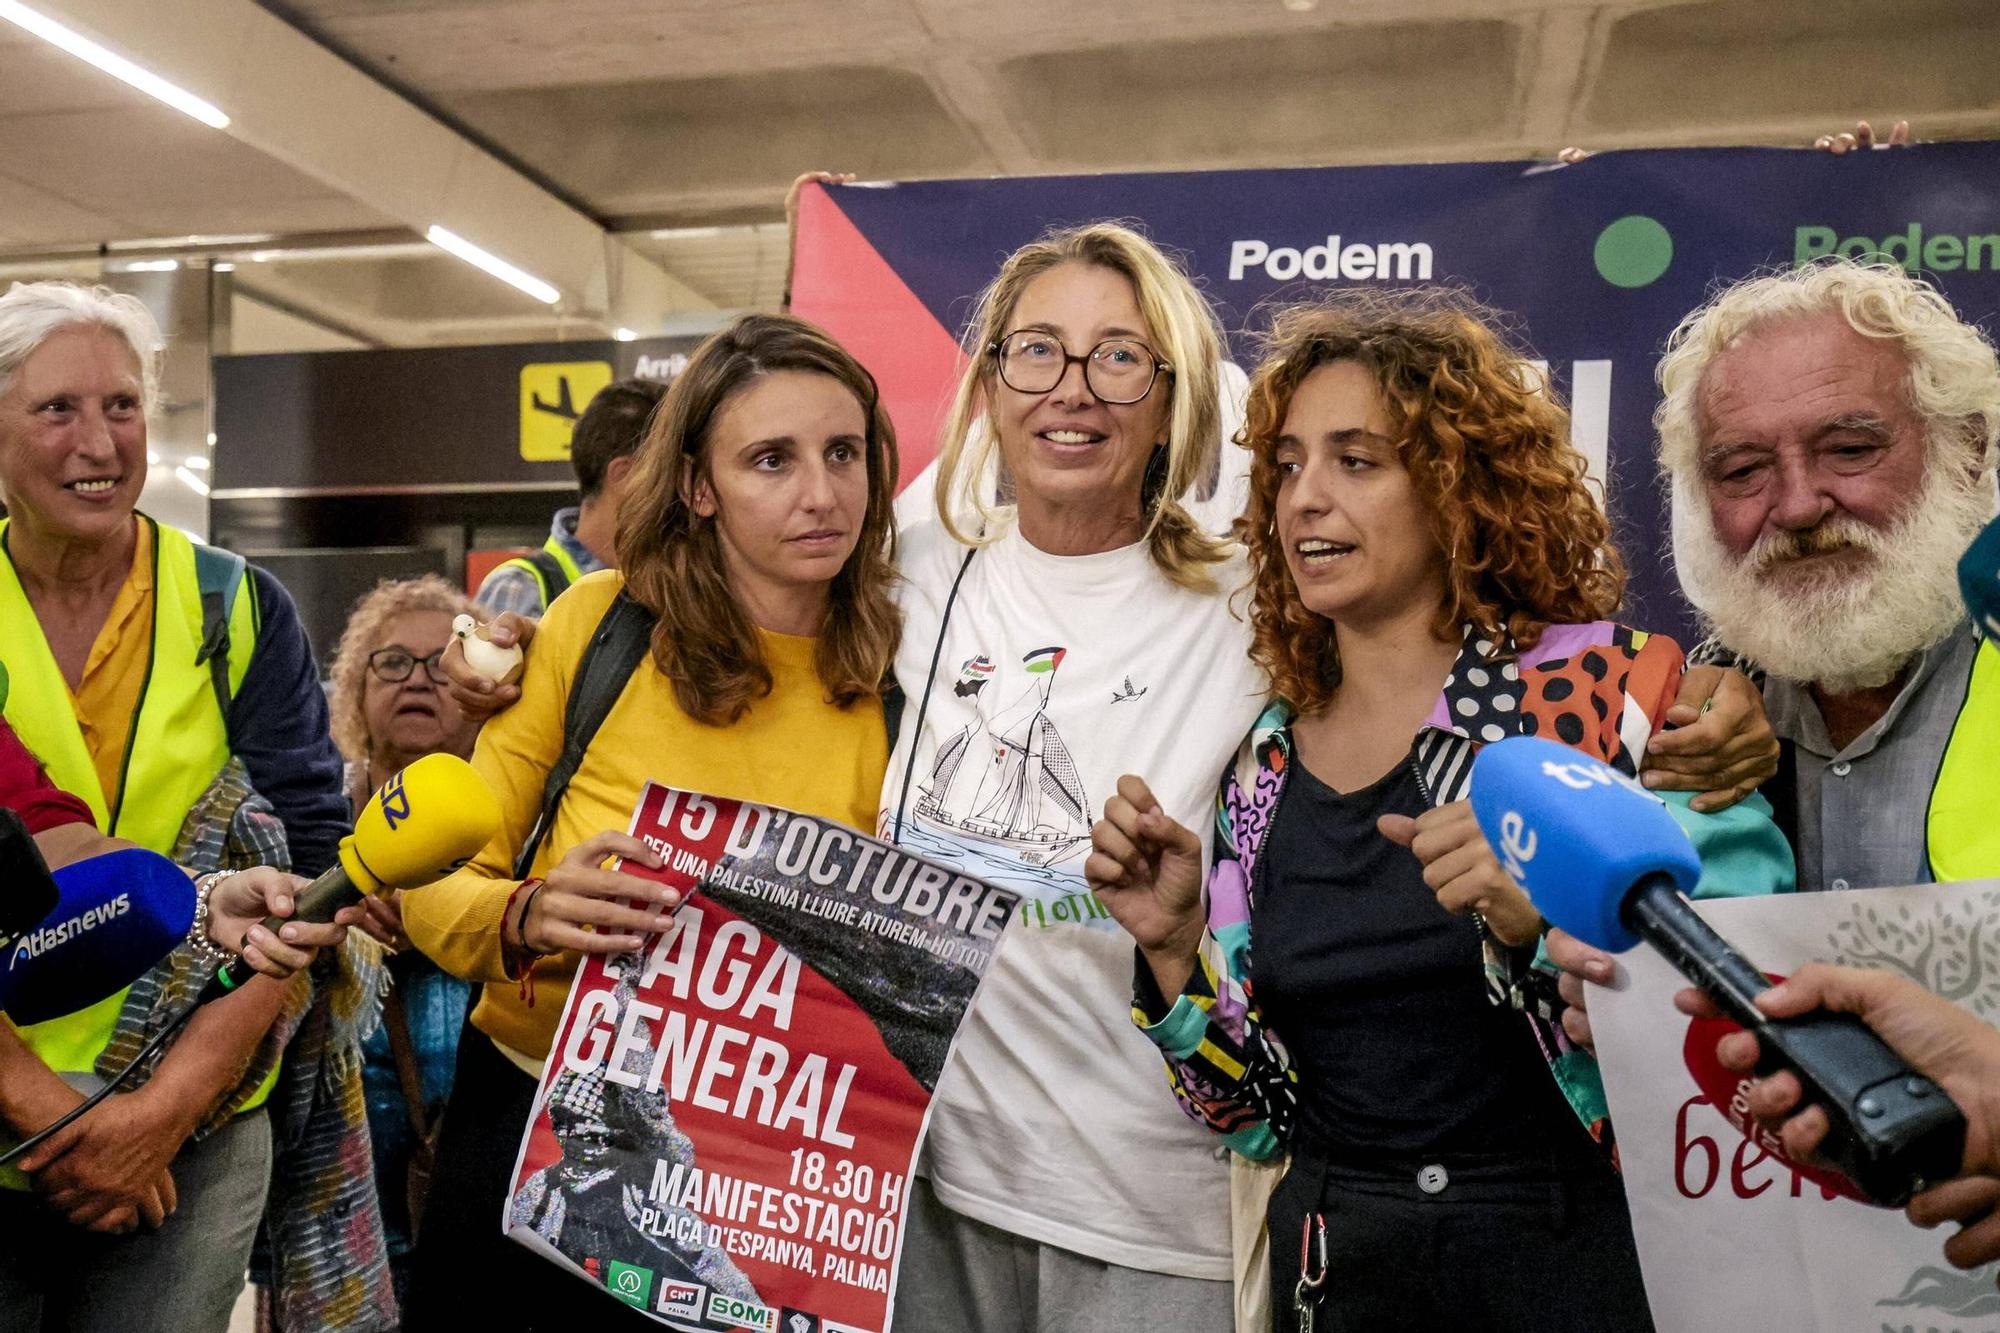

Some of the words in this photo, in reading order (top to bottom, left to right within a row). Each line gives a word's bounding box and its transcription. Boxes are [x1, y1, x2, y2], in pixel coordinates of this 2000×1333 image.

[1228, 234, 1433, 281] Podem
[657, 790, 717, 841] 15
[723, 802, 1019, 942] D'OCTUBRE
[672, 849, 708, 881] UNA
[709, 863, 800, 909] PALESTINA
[800, 893, 860, 926] LLIURE
[857, 911, 957, 958] ATUREM-HO
[9, 893, 130, 971] Atlasnews
[563, 989, 858, 1149] GENERAL
[649, 1158, 896, 1260] MANIFESTACIÓ
[789, 1147, 875, 1205] 18.30
[879, 1171, 903, 1213] H
[638, 1207, 703, 1246] PLAÇA
[707, 1225, 817, 1278] D'ESPANYA,
[822, 1252, 888, 1293] PALMA
[668, 1306, 690, 1316] PALMA
[669, 1289, 694, 1302] CNT
[711, 1297, 766, 1324] SOM
